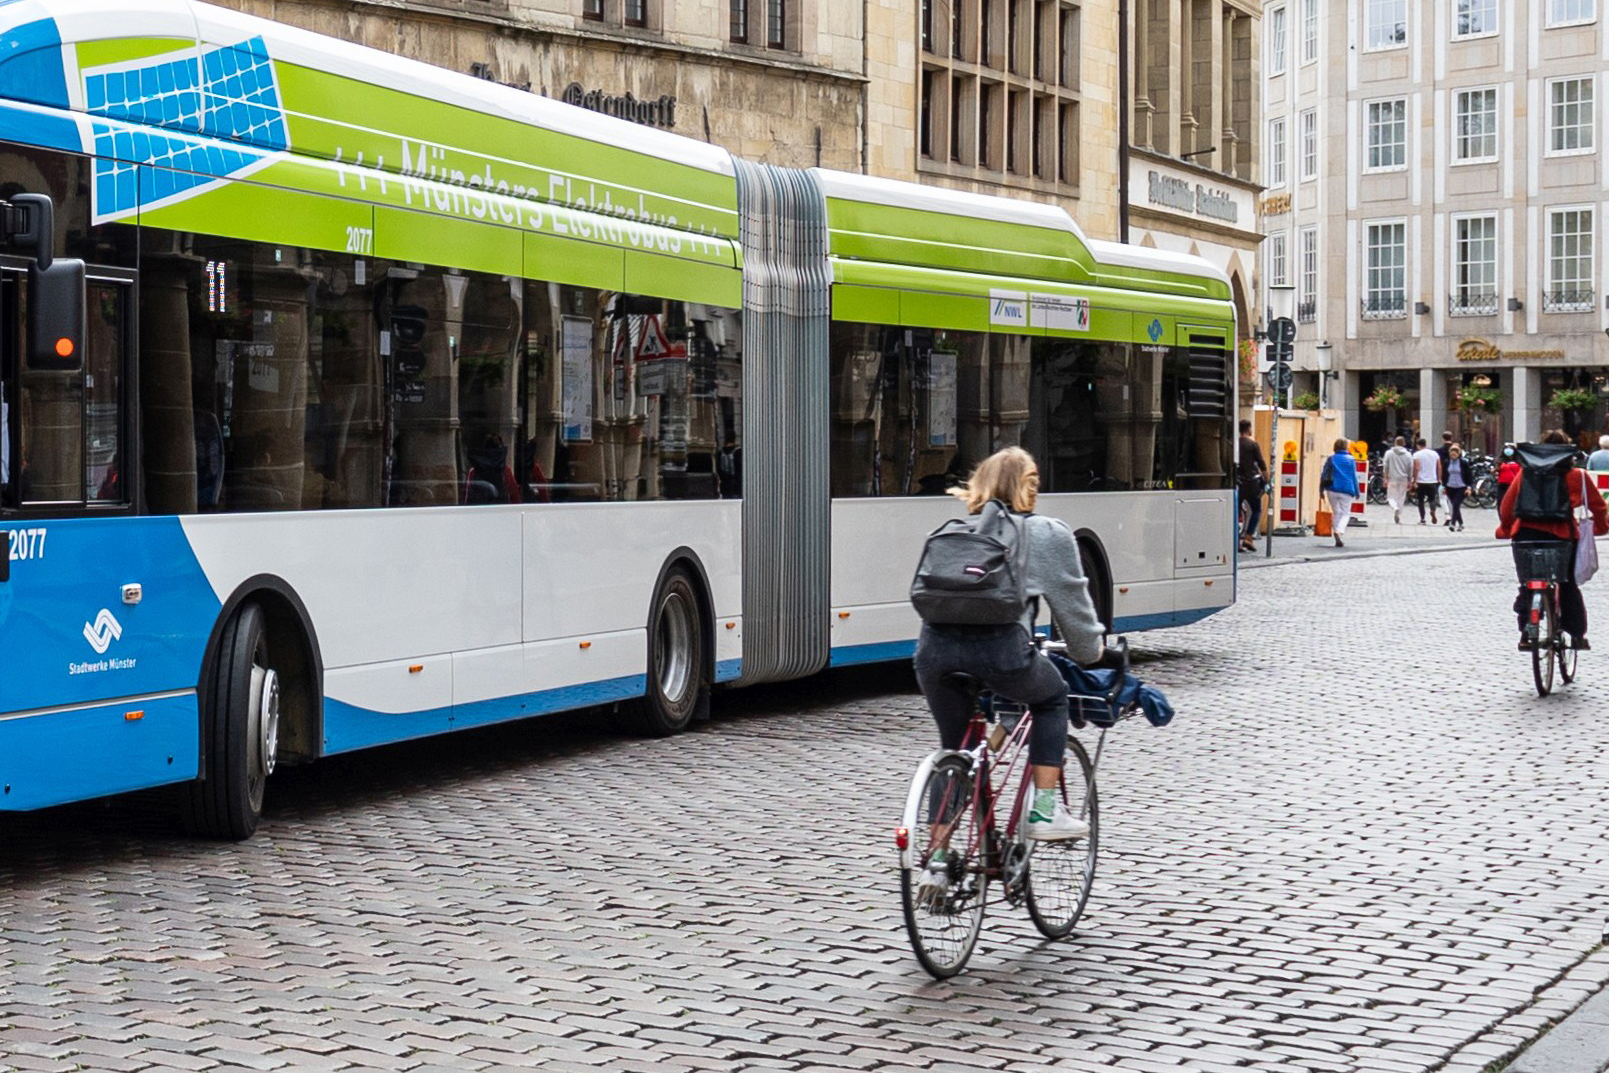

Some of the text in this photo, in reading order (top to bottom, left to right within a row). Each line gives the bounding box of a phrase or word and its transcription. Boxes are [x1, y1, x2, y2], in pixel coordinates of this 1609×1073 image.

[401, 138, 543, 229] Münsters
[548, 173, 682, 255] Elektrobus
[345, 227, 374, 254] 2077
[205, 260, 226, 312] 11
[1004, 305, 1022, 318] NWL
[8, 528, 47, 561] 2077
[69, 658, 136, 675] Stadtwerke Münster
